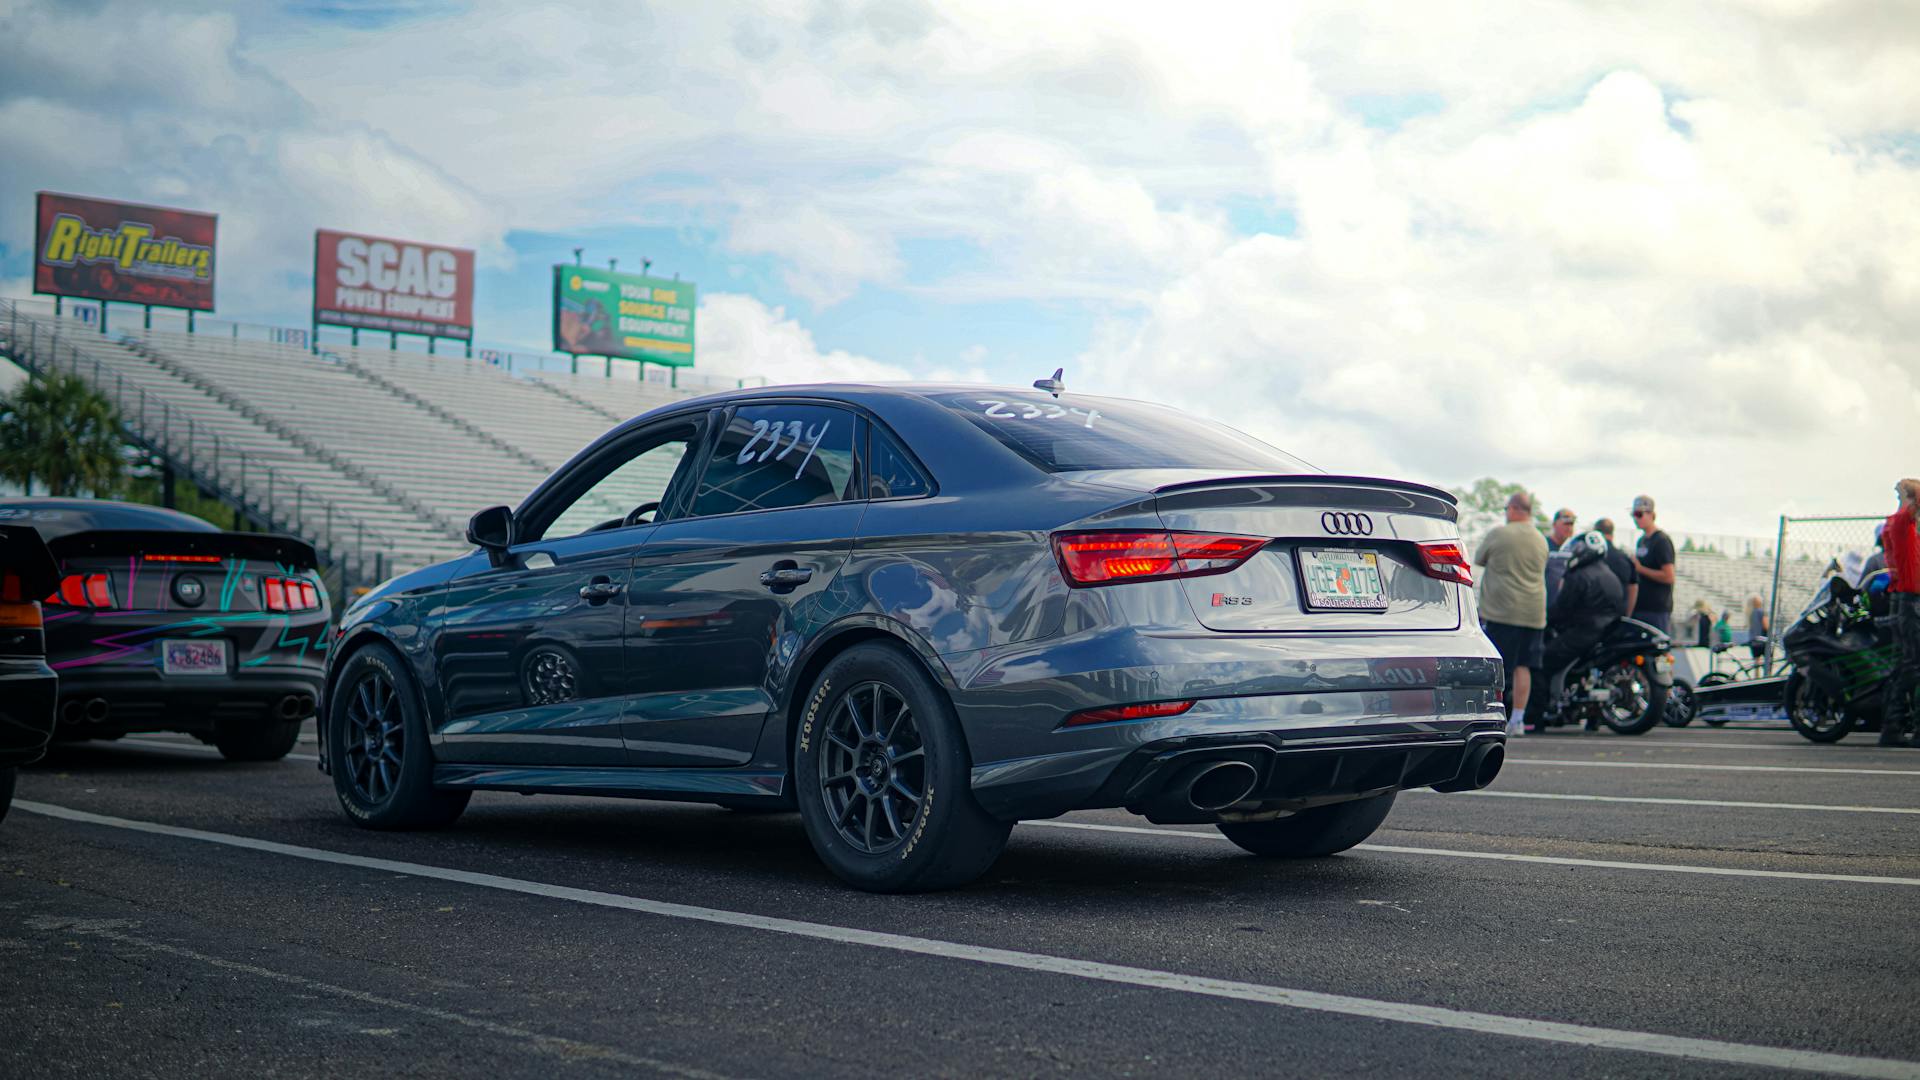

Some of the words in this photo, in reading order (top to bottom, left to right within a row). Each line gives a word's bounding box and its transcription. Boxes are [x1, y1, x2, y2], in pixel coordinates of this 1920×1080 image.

[336, 237, 457, 298] SCAG
[976, 400, 1101, 428] 2334
[736, 419, 830, 480] 2334
